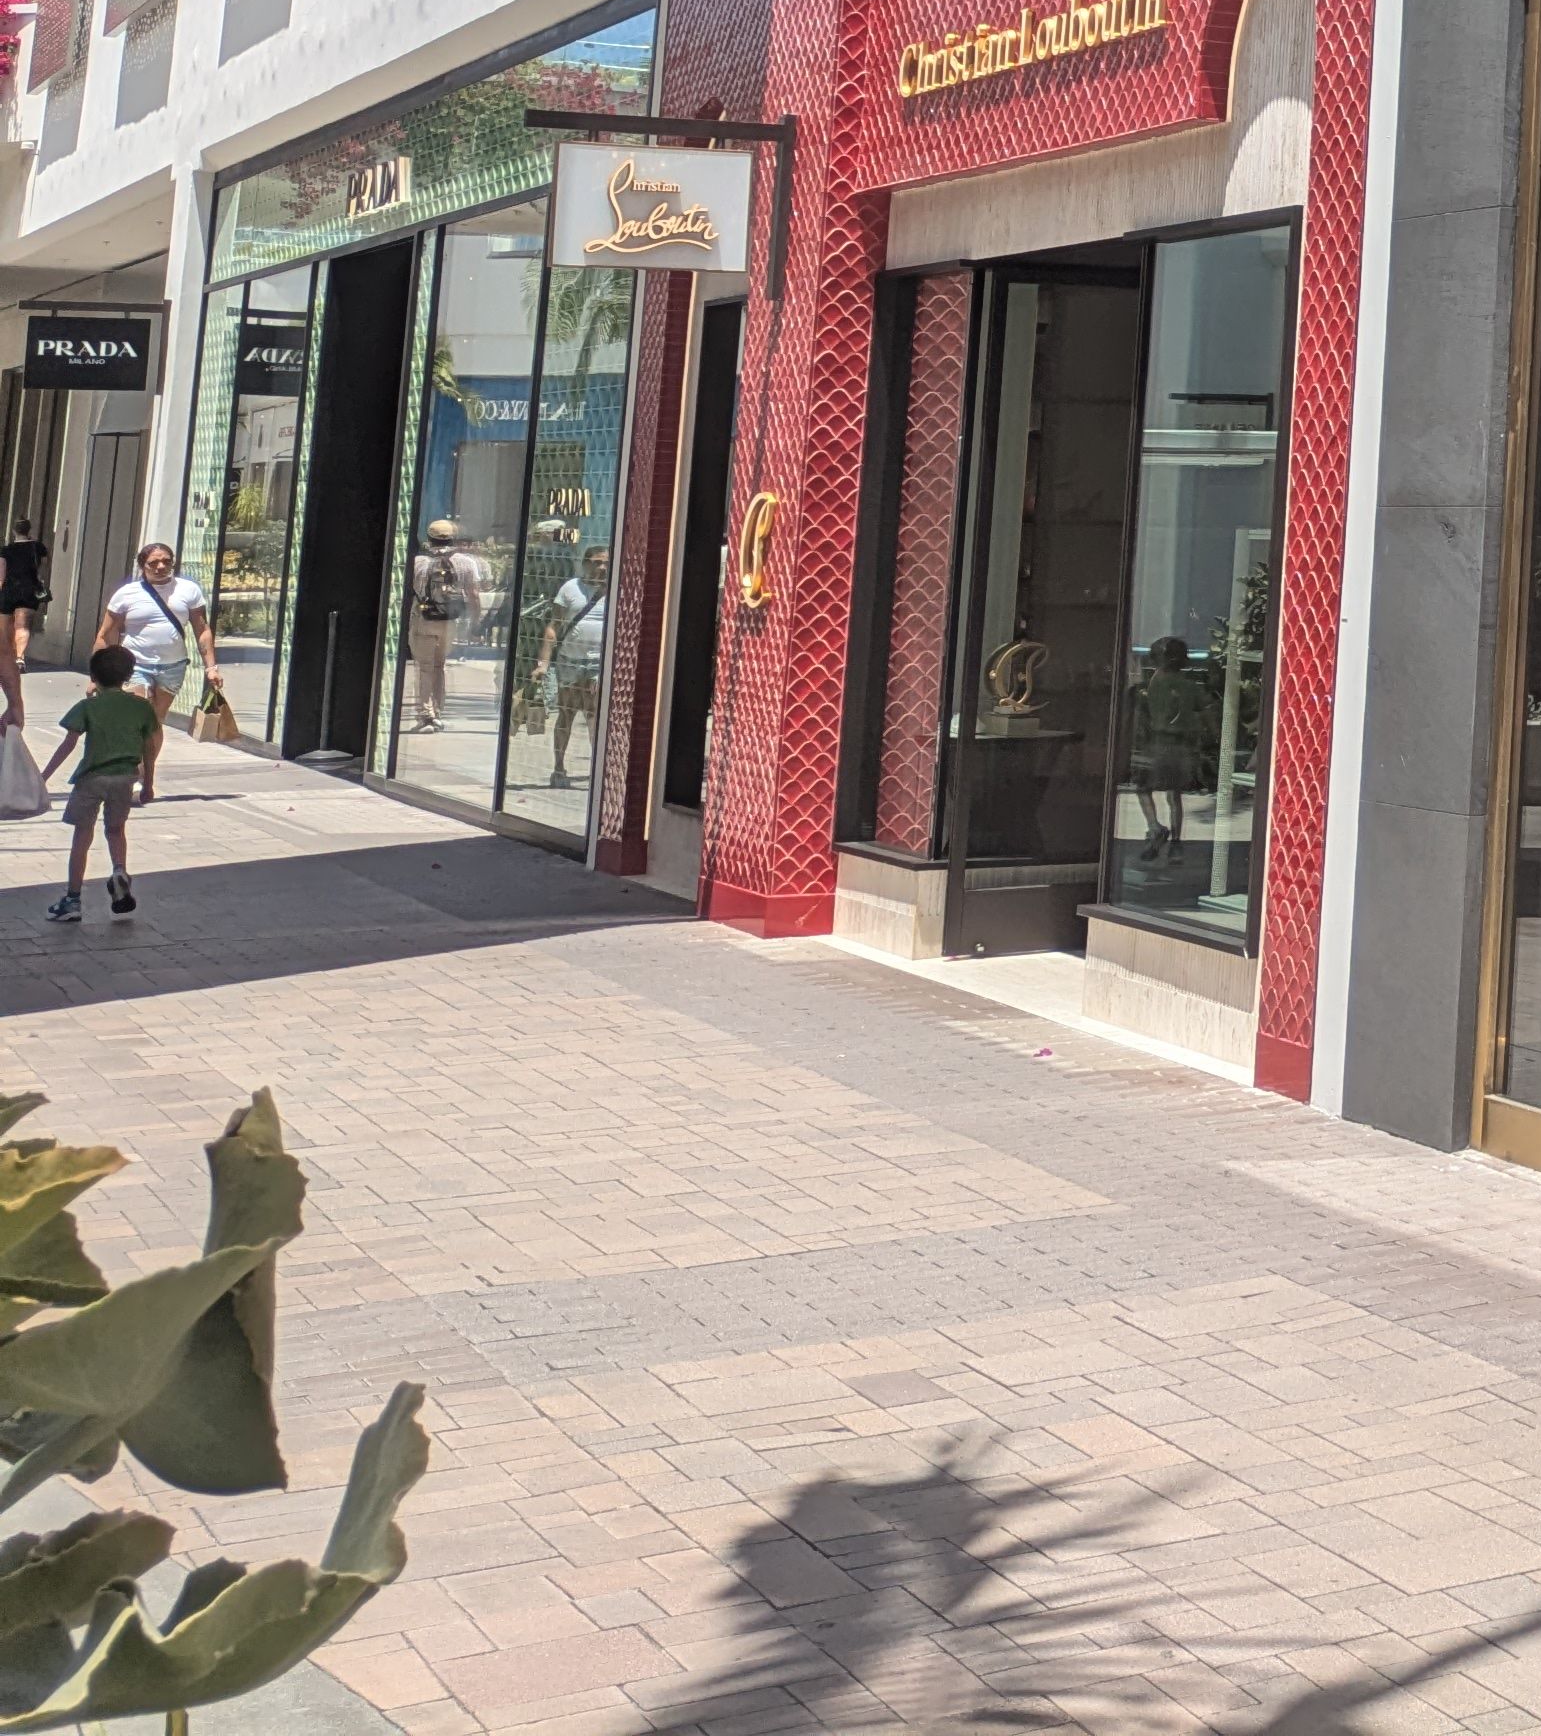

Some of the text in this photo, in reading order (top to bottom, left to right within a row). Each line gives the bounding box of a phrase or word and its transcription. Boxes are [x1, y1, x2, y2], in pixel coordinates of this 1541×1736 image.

[899, 24, 1020, 98] Christian
[584, 158, 719, 253] Louboutin
[37, 339, 138, 358] PRADA
